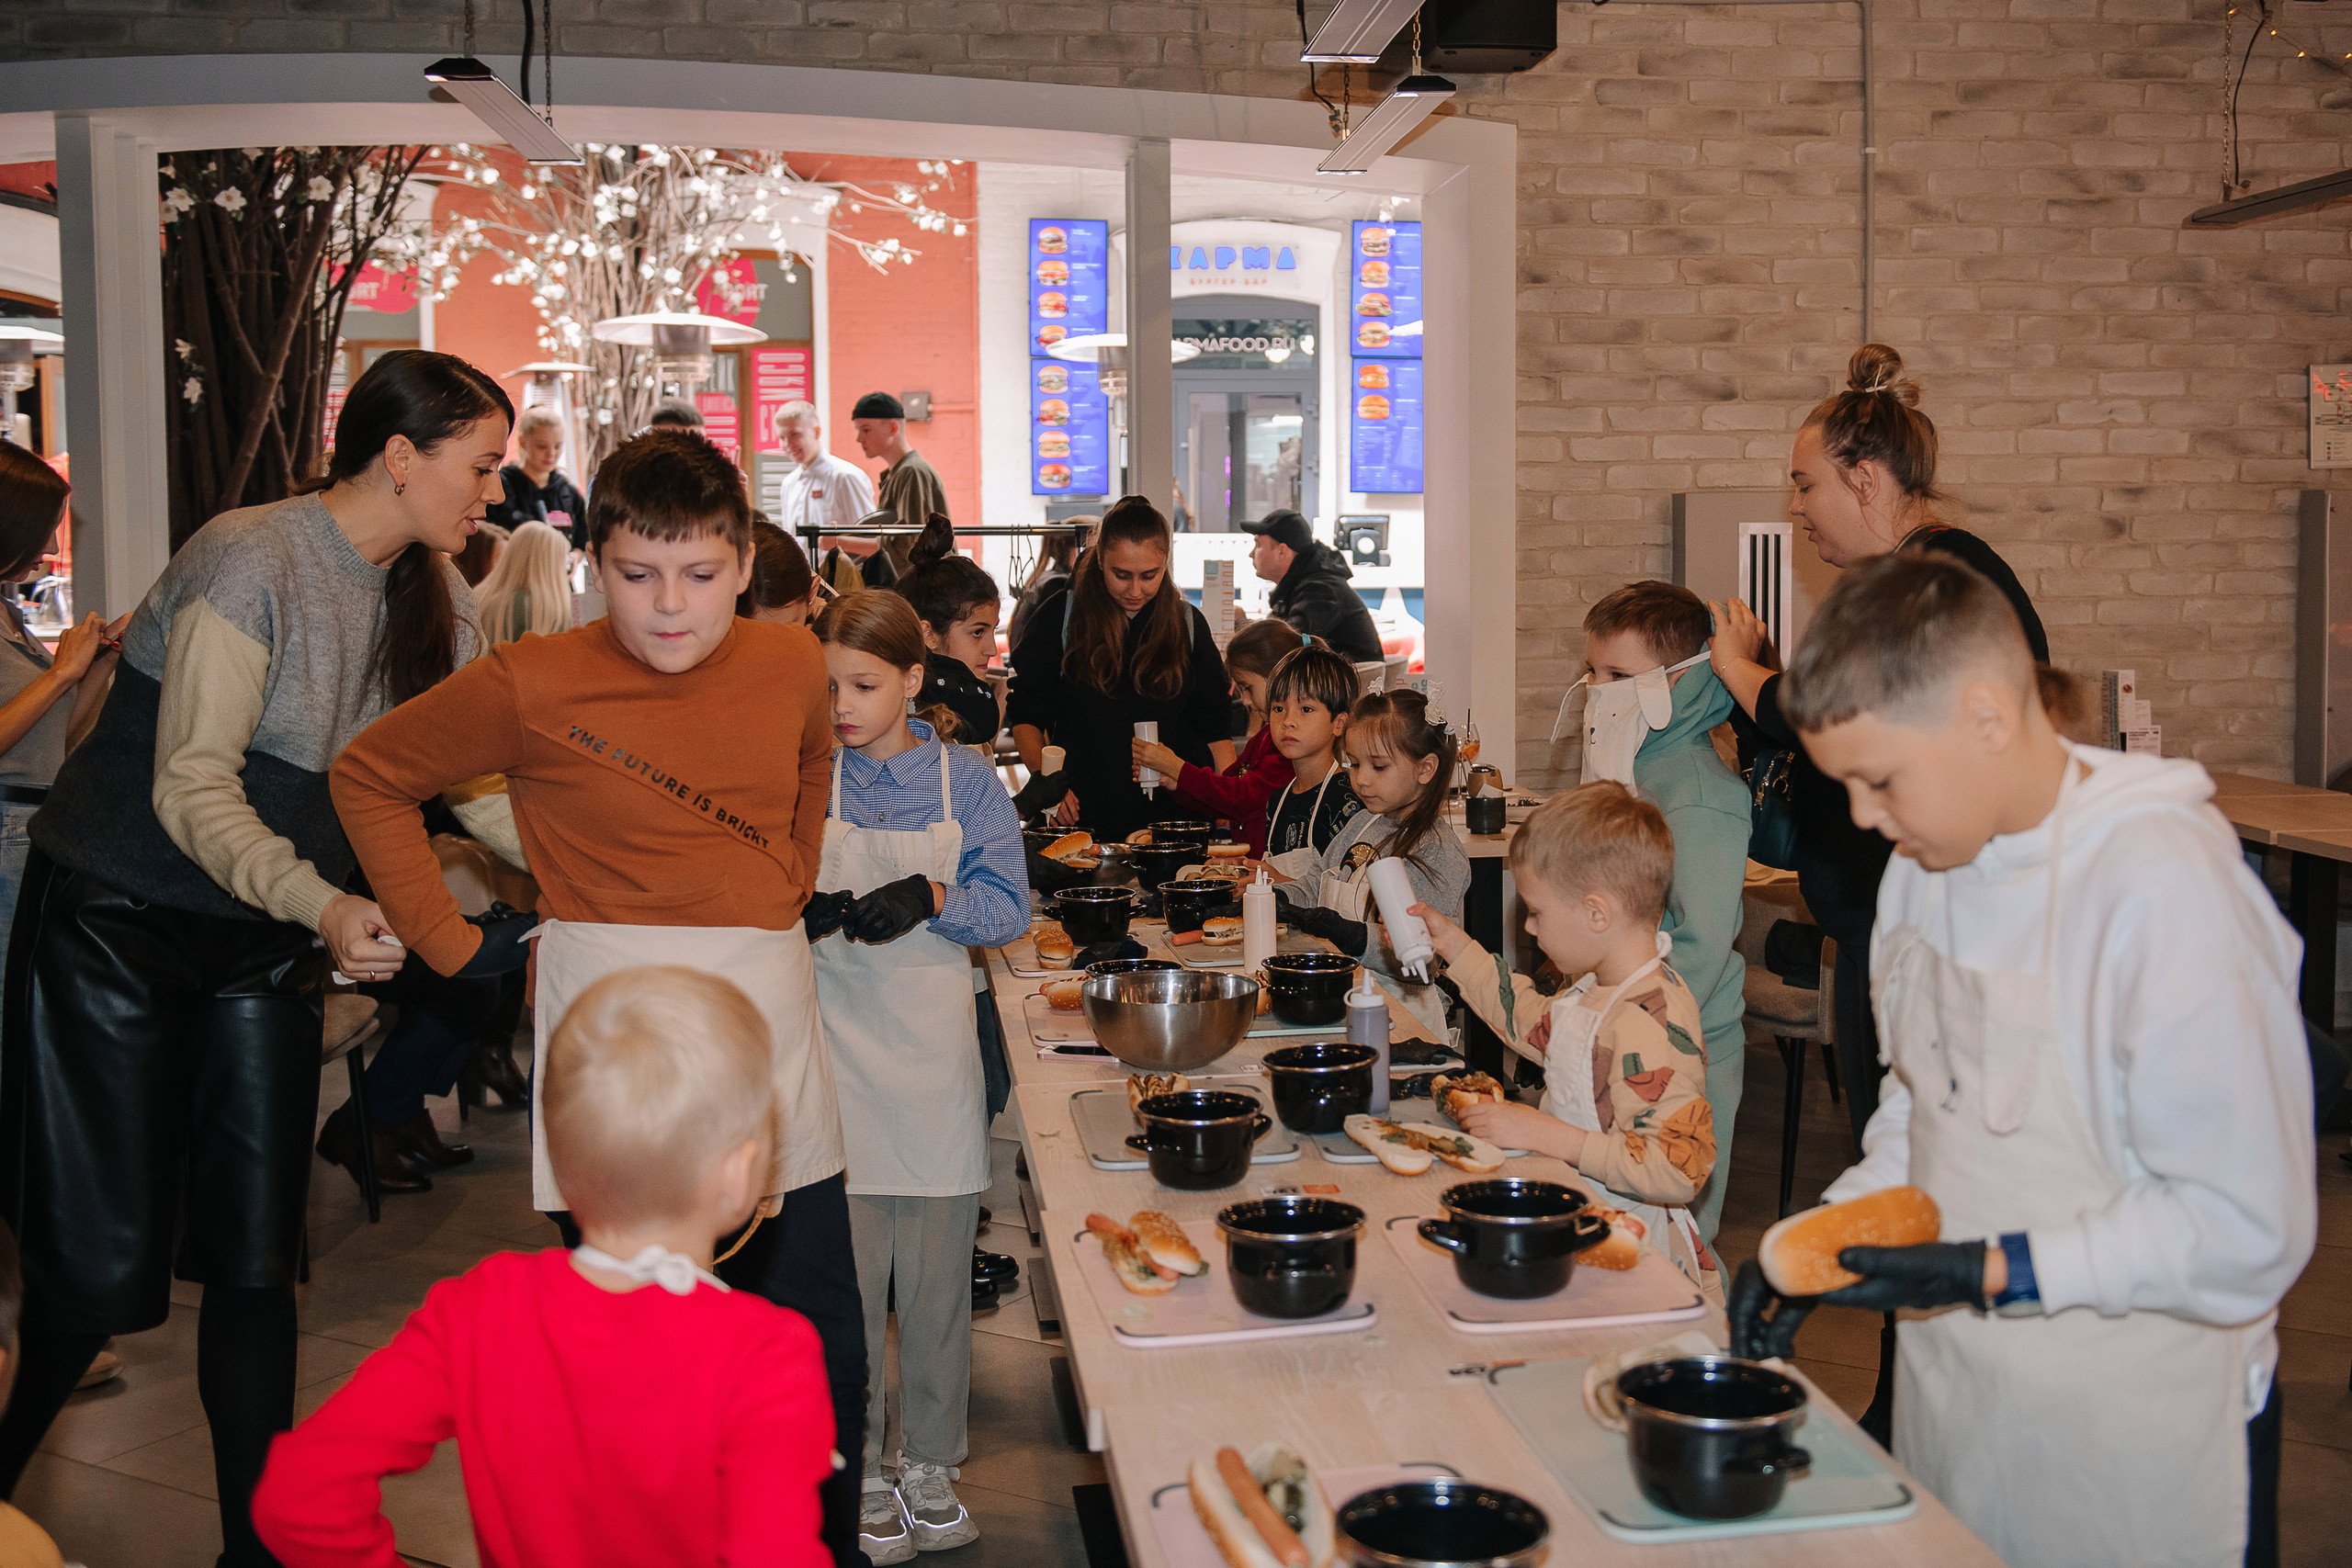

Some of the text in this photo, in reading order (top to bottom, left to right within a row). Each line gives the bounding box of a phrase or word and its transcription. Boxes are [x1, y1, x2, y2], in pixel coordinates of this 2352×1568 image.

[567, 725, 769, 850] THE FUTURE IS BRIGHT
